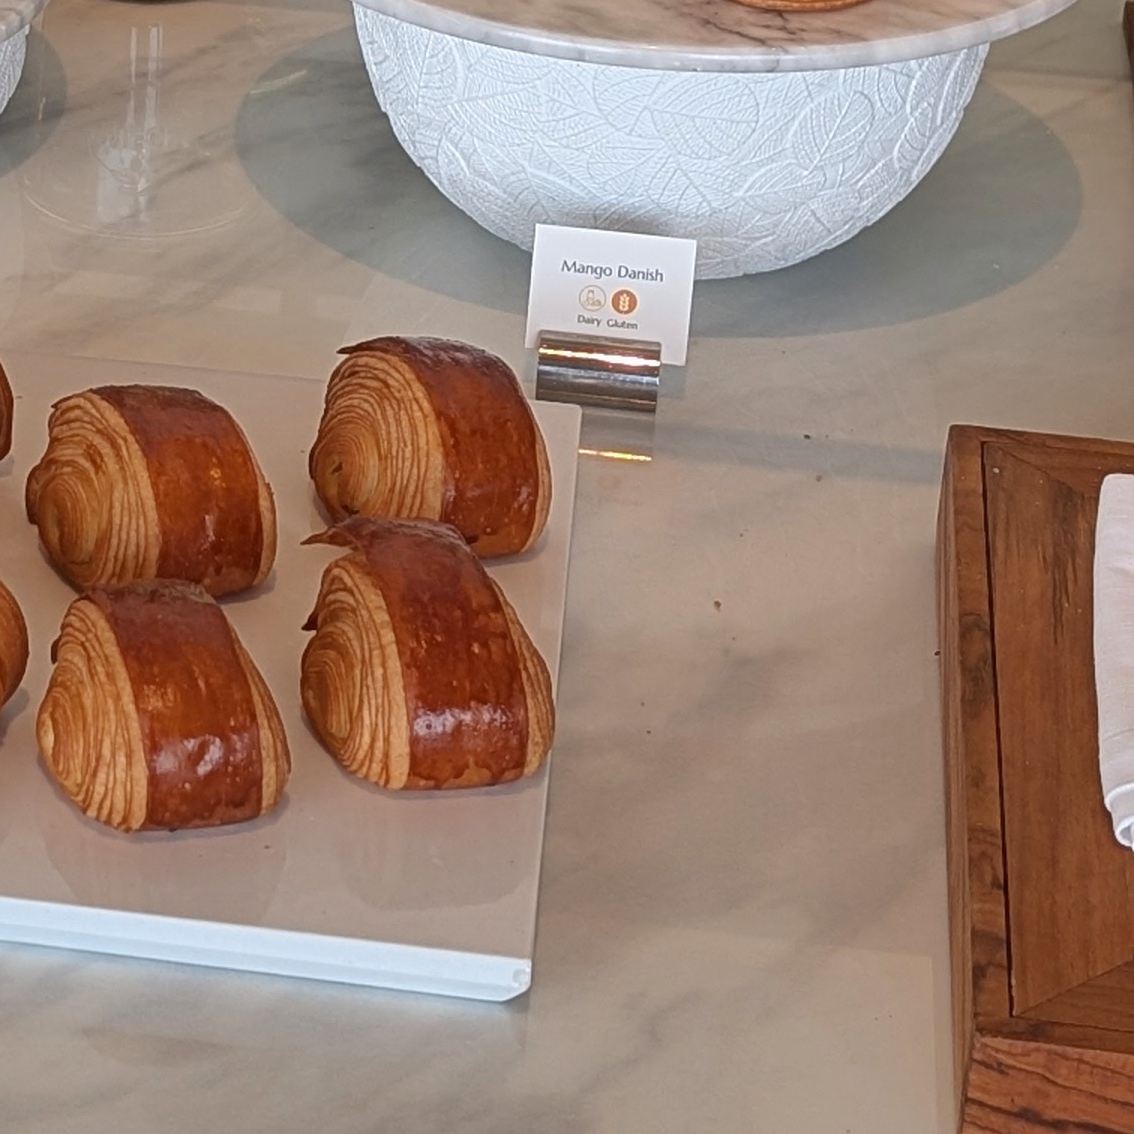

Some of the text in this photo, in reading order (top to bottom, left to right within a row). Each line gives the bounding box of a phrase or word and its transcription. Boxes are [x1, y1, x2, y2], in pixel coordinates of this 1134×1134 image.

[561, 259, 664, 282] Mango Danish
[577, 314, 638, 330] Dairy Gluten
